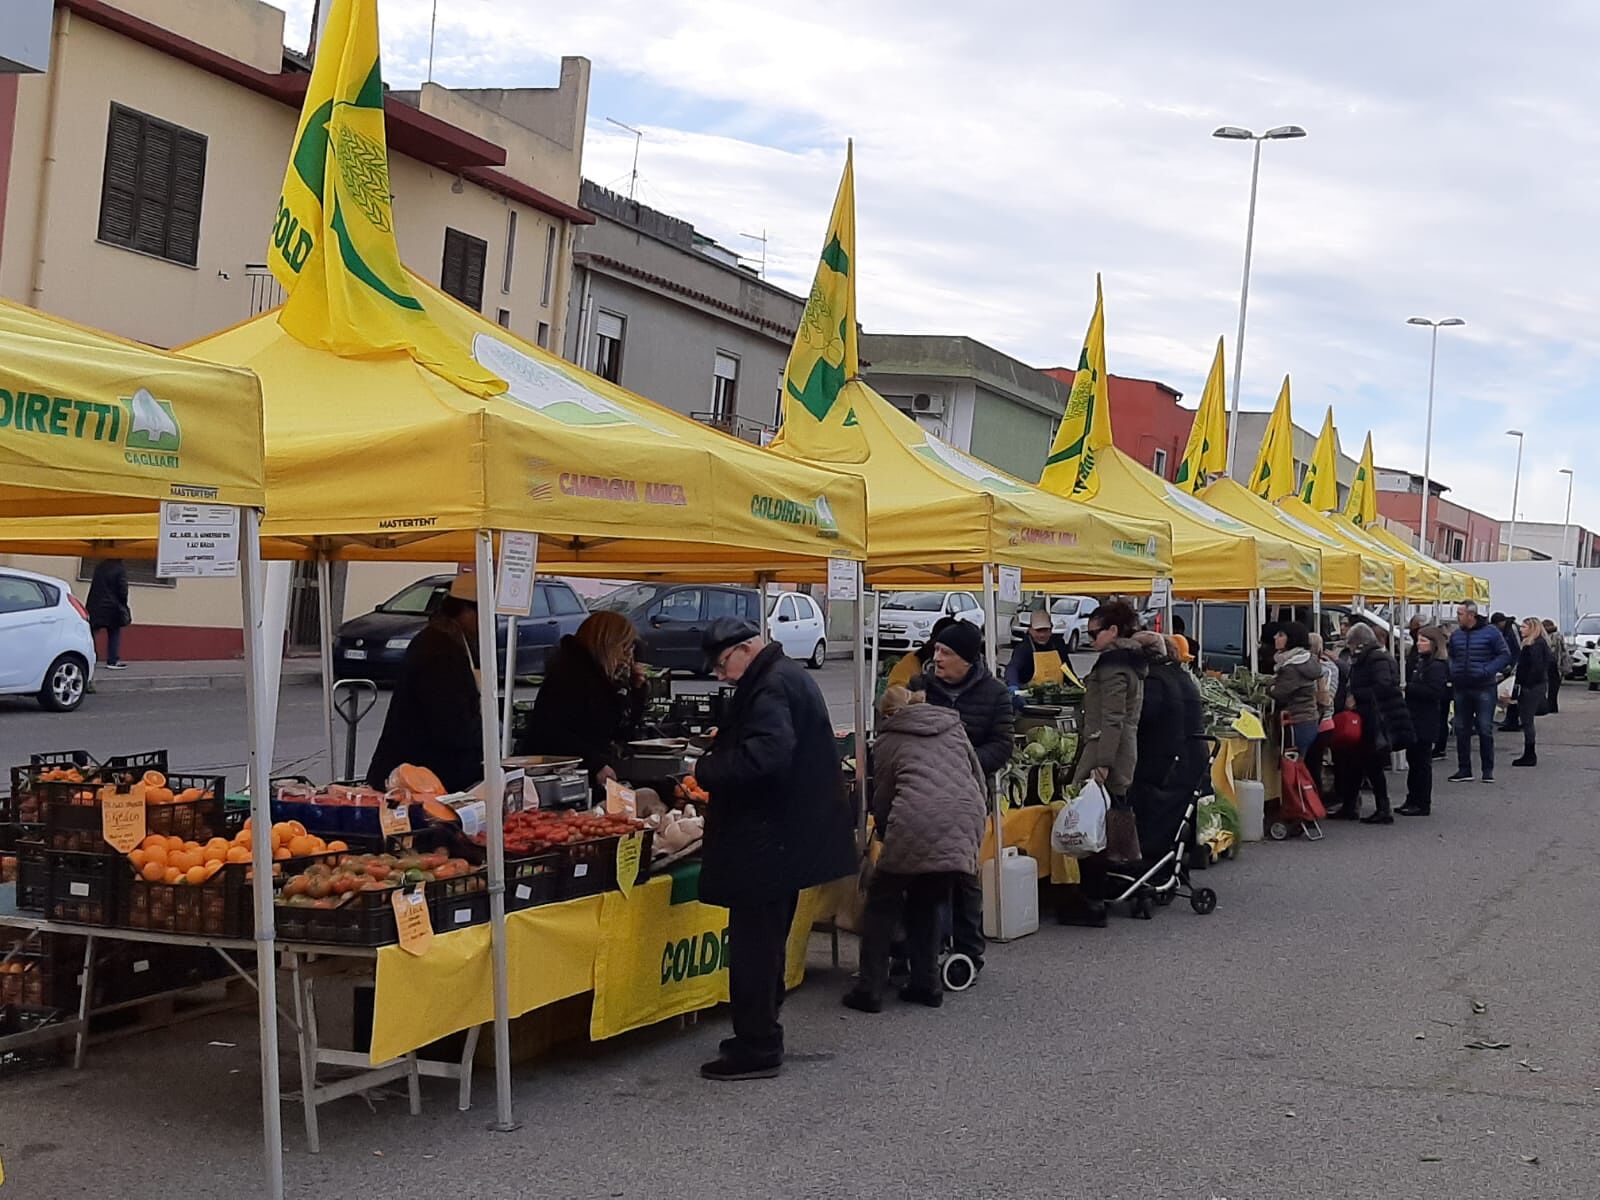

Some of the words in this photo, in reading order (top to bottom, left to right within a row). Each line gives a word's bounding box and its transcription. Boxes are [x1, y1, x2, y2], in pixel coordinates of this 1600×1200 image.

[124, 451, 179, 469] CAGLIARI
[751, 494, 818, 526] COLDIRETTI
[379, 517, 438, 529] MASTERTENT
